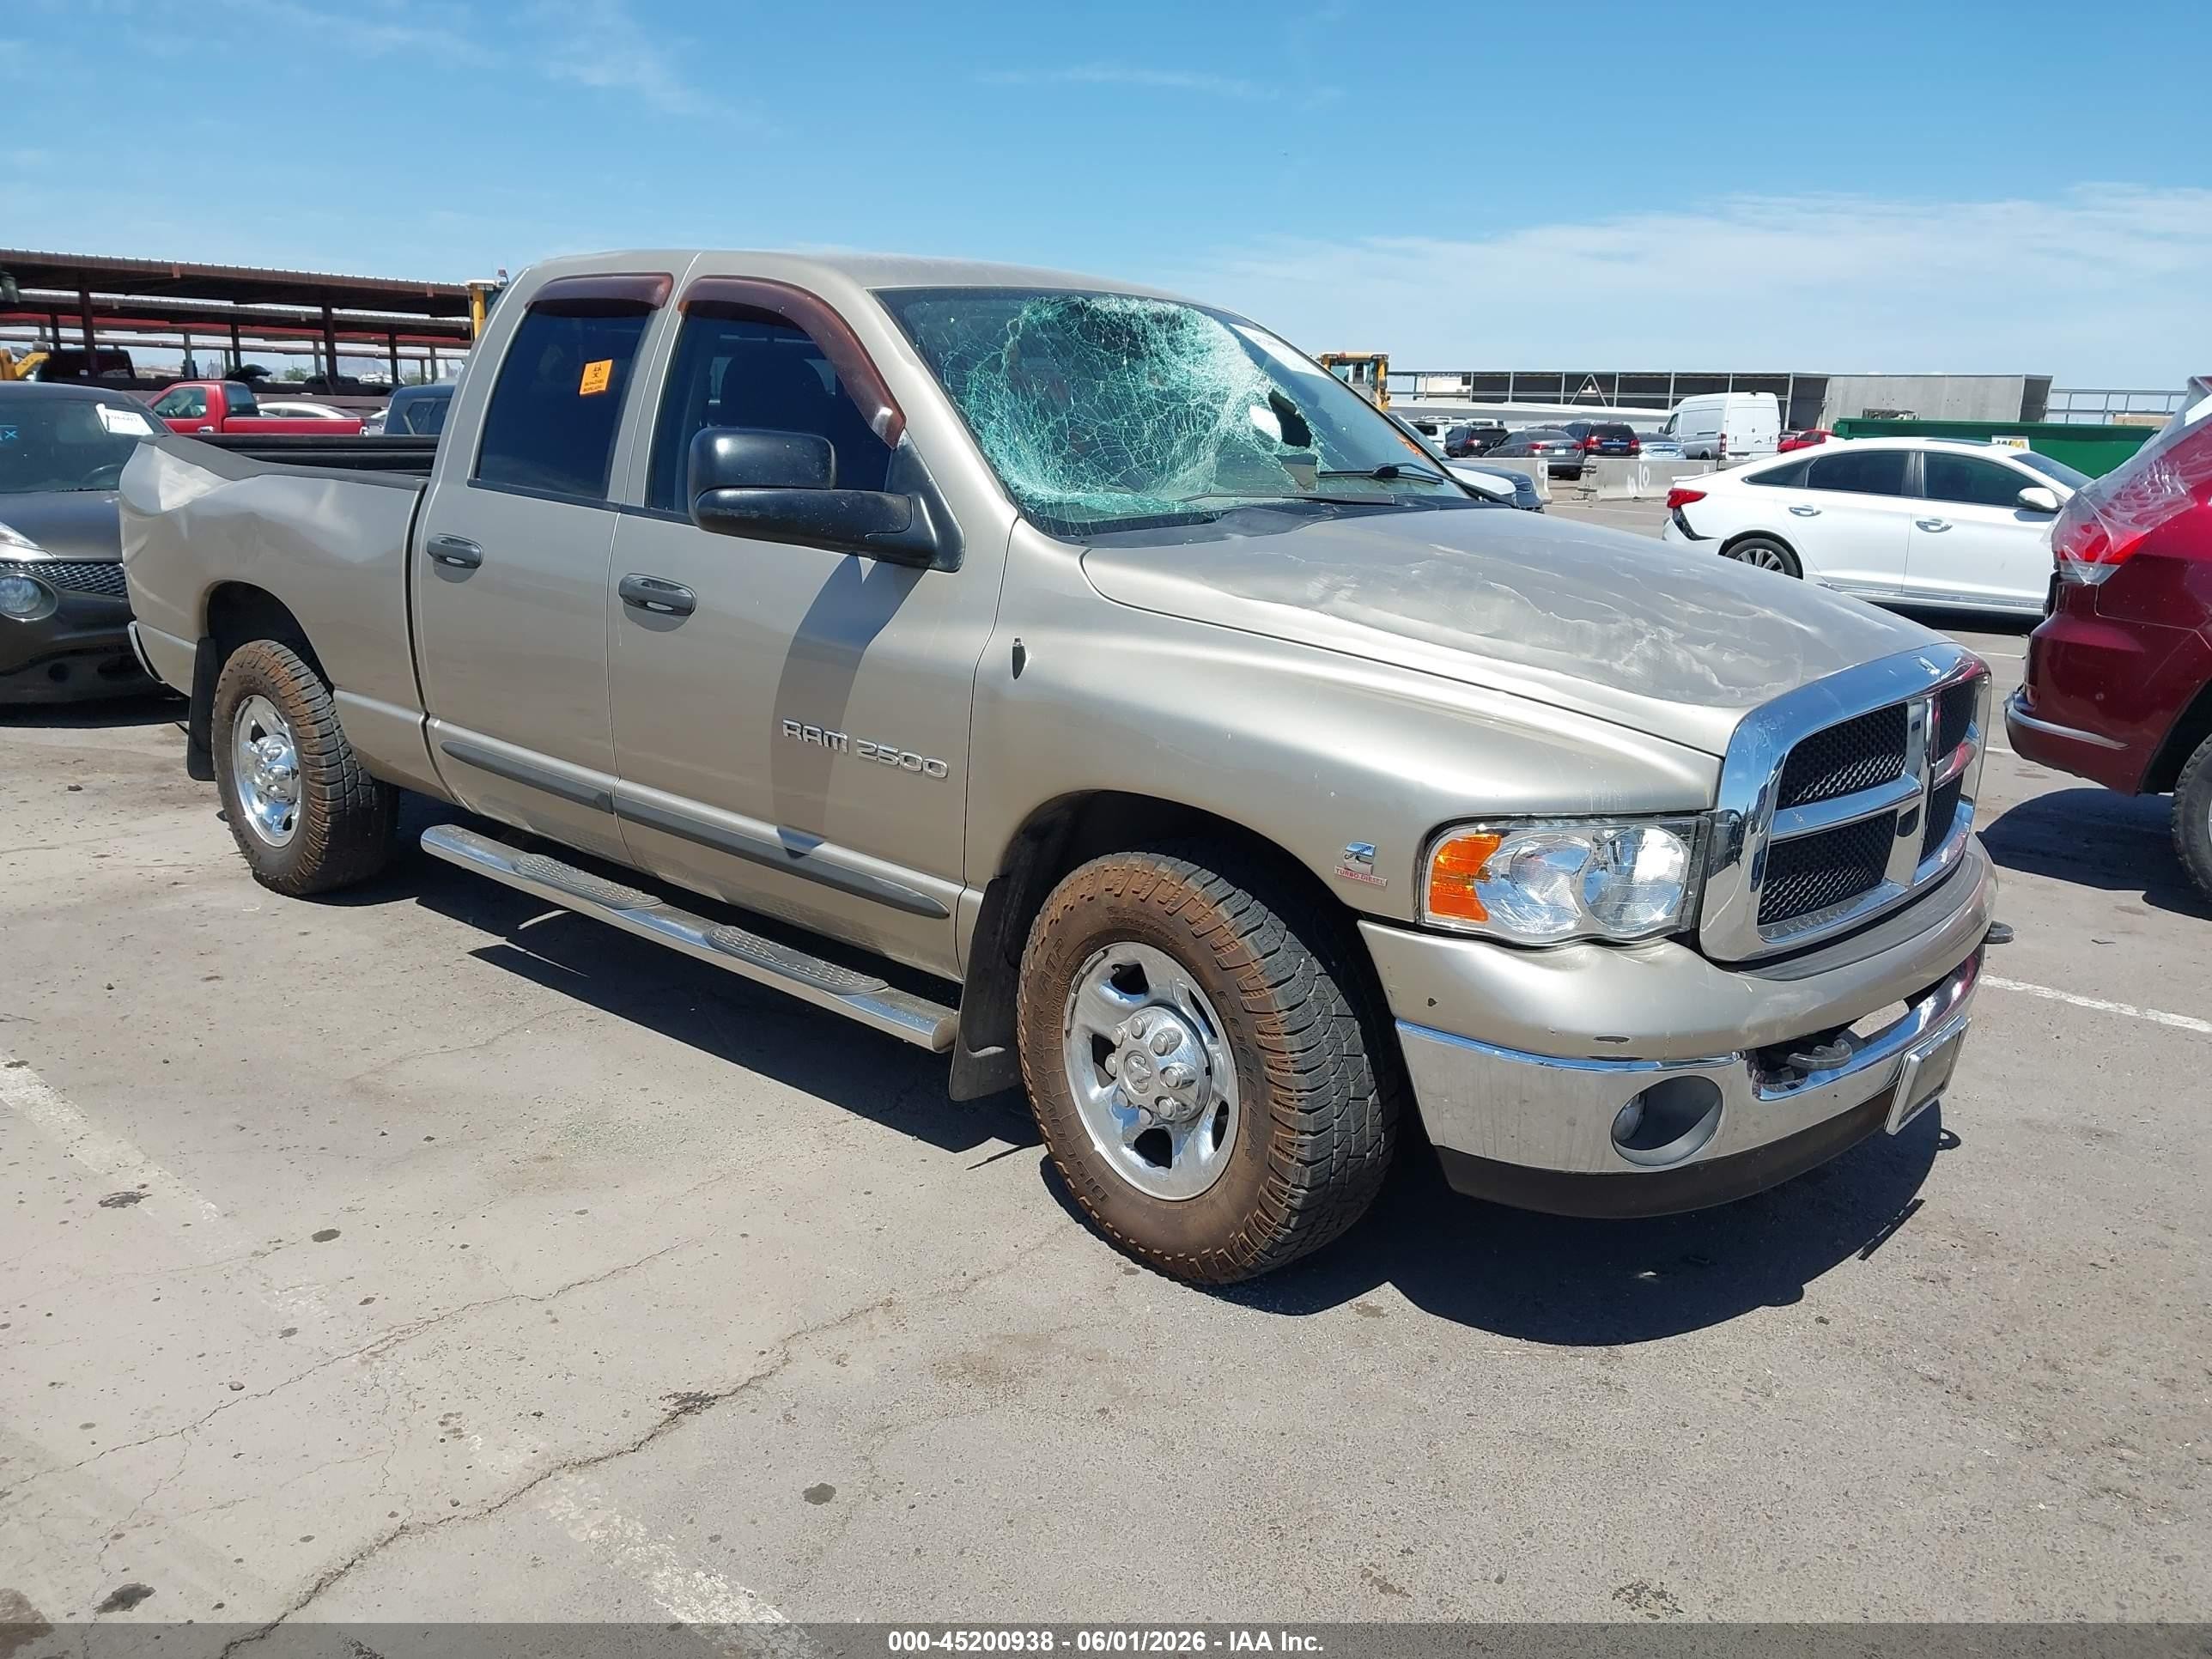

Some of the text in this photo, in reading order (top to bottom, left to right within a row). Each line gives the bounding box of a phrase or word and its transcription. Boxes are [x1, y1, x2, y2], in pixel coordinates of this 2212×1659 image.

[782, 718, 949, 779] RAM 2500
[1344, 845, 1372, 860] Cummins
[1336, 867, 1384, 885] TURBO DIESEL
